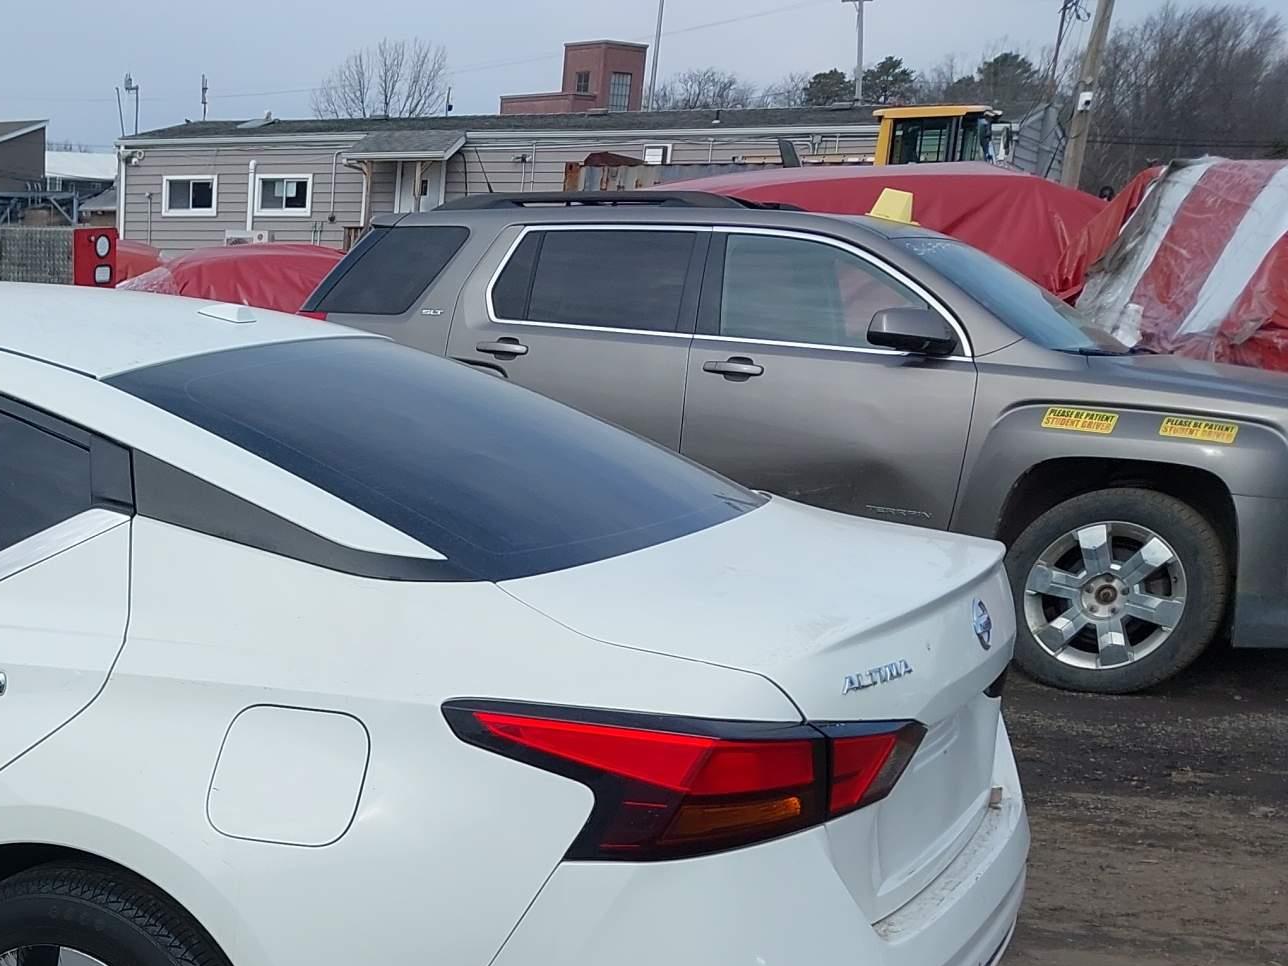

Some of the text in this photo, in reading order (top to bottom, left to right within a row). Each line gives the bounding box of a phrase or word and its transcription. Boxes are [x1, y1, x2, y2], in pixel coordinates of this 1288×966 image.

[1044, 417, 1081, 427] STUDENT
[1048, 408, 1115, 422] PLEASE BE PATIENT
[1162, 425, 1199, 436] STUDENT
[1165, 418, 1235, 433] PLEASE BE PATIENT
[842, 659, 914, 695] ALTIMA
